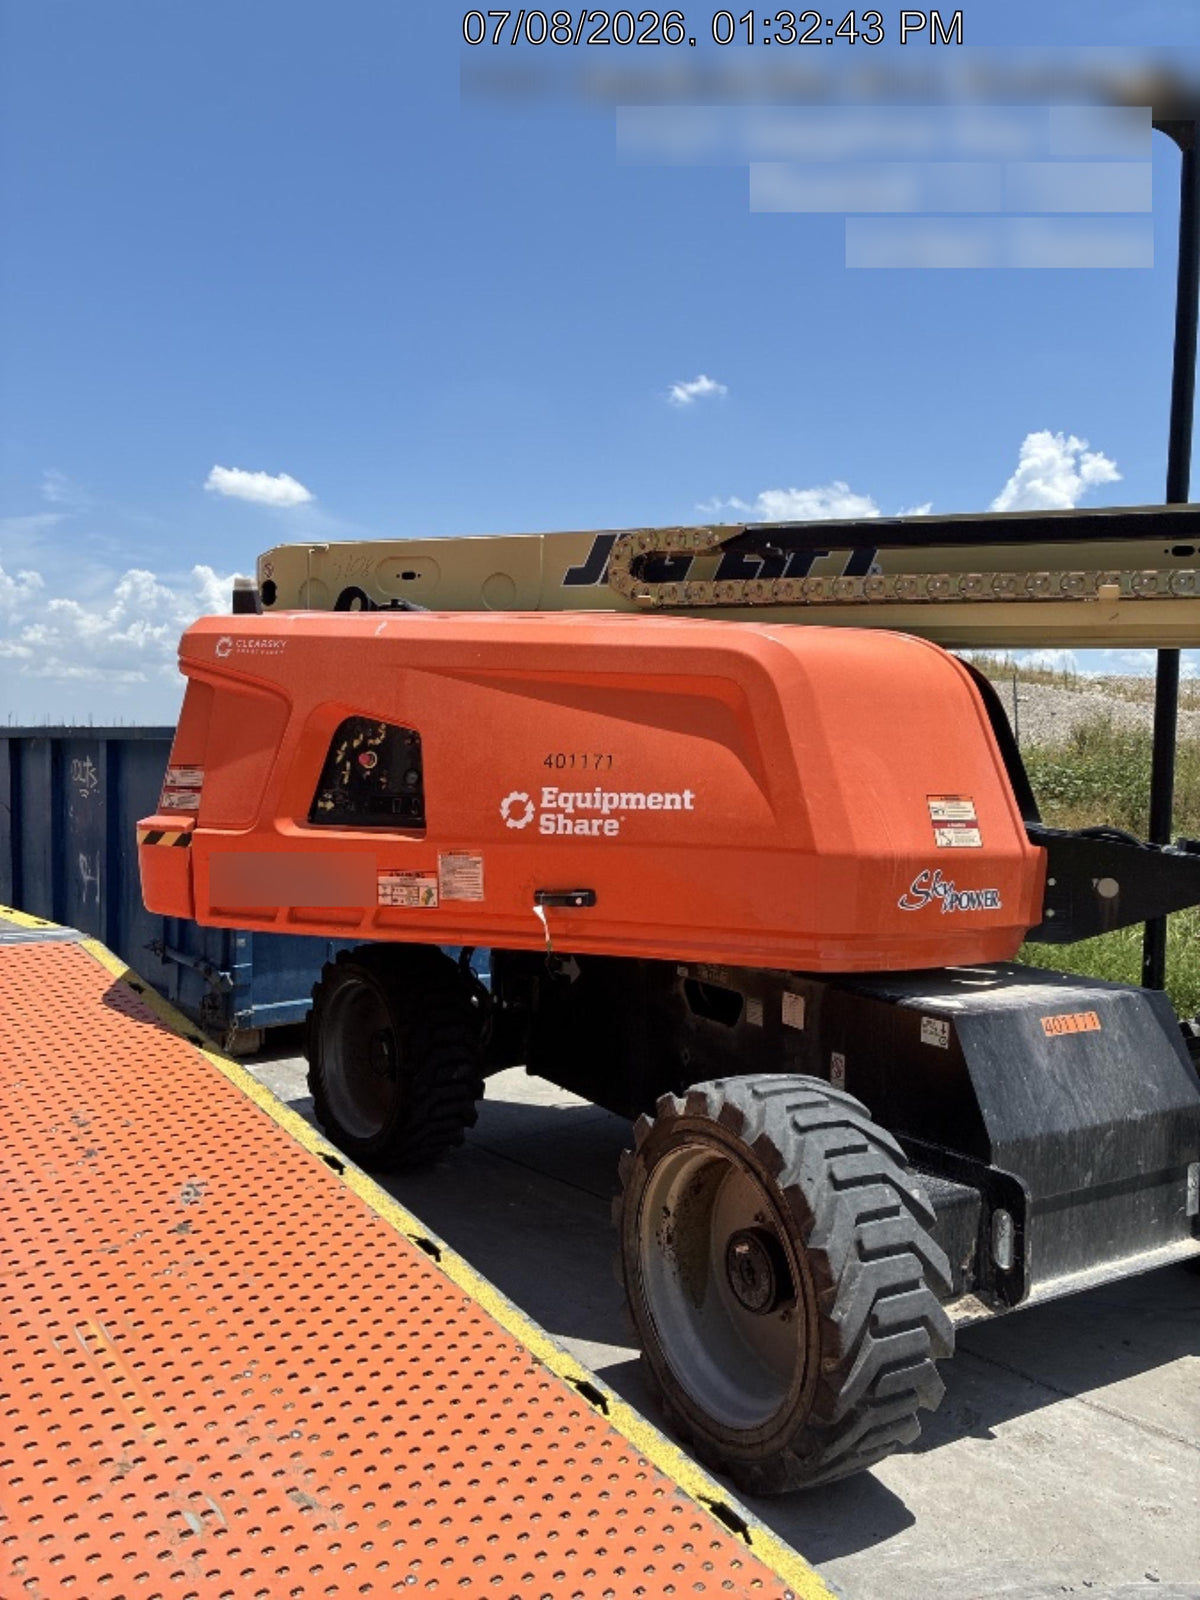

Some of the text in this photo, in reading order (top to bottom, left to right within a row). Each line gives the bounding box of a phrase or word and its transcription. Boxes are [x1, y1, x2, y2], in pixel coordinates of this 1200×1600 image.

[543, 753, 613, 770] 401171
[540, 786, 696, 815] Equipment
[538, 813, 620, 836] Share
[1043, 1012, 1098, 1034] 401171
